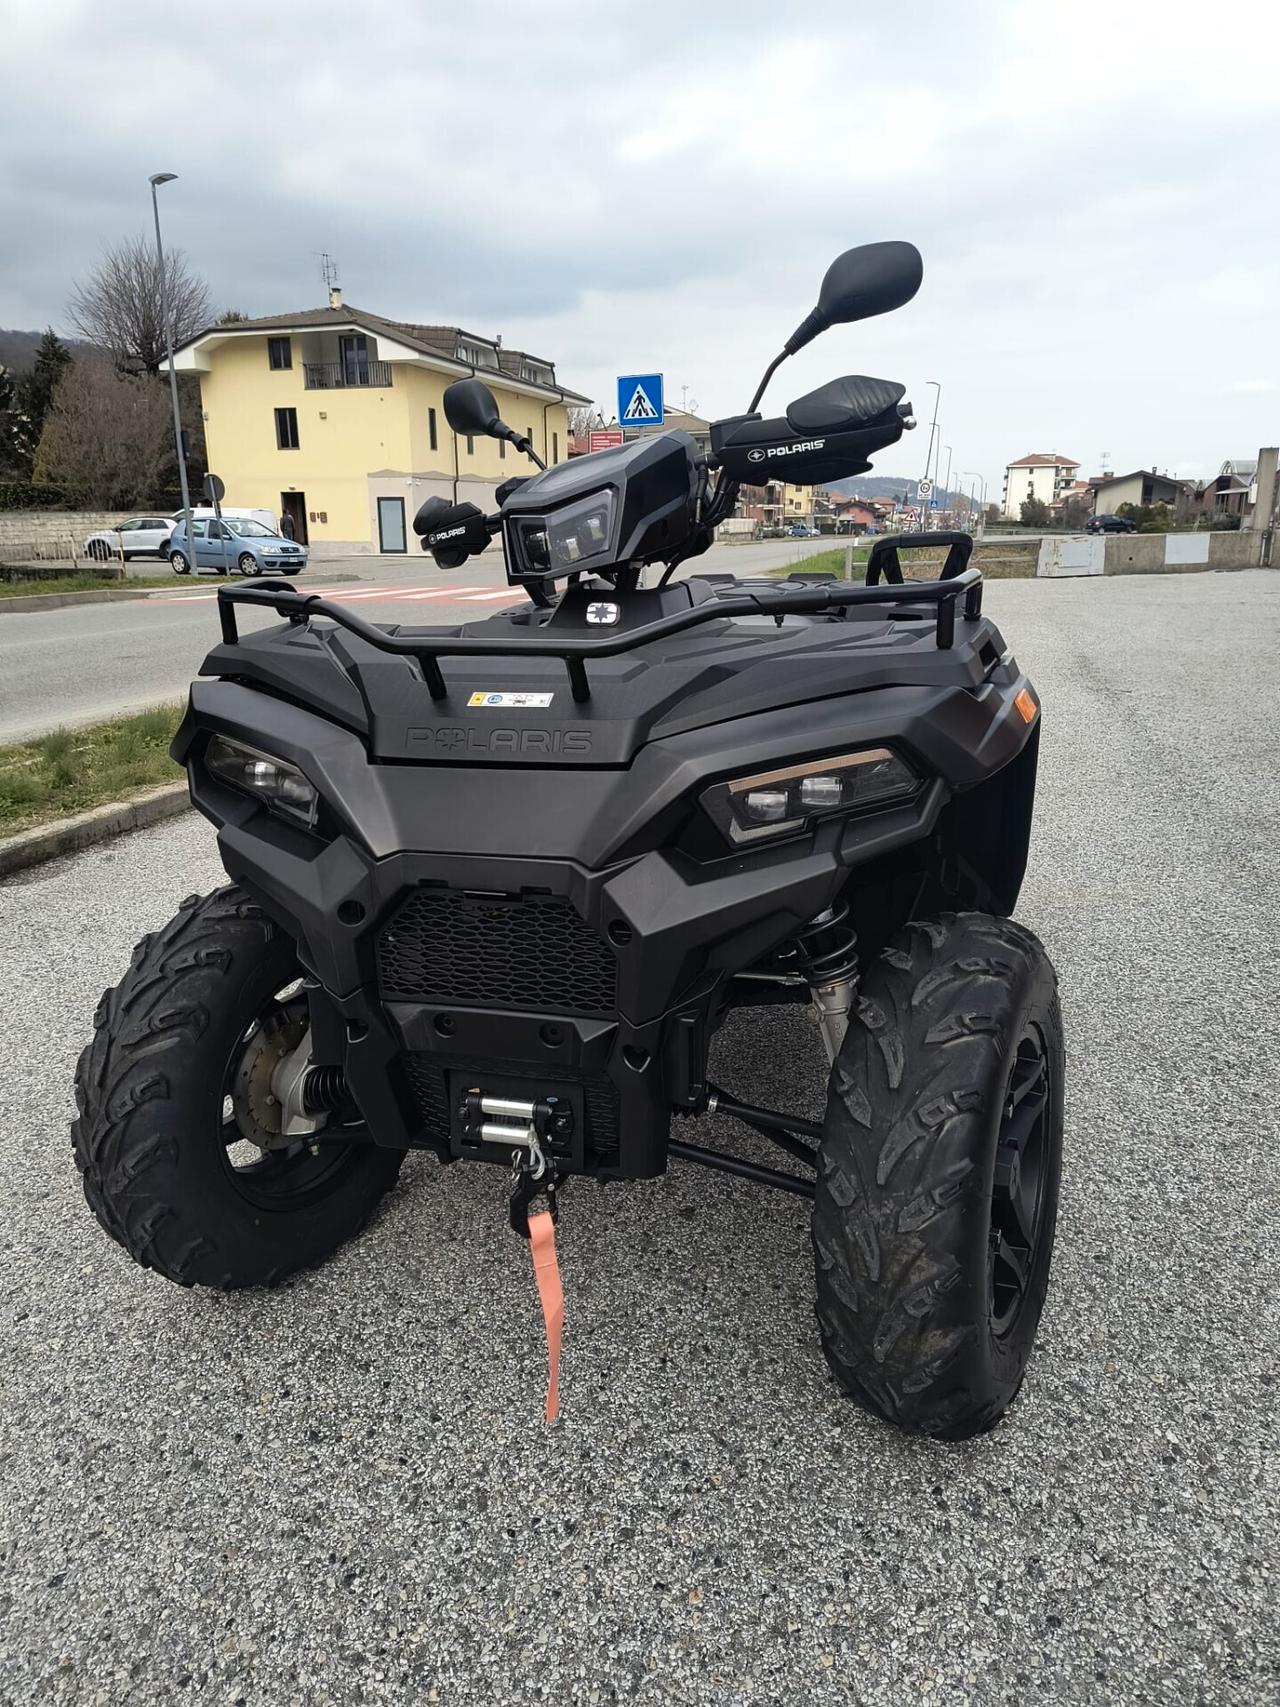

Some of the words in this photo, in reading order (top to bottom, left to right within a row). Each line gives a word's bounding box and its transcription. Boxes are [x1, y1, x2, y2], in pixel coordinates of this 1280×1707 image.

[767, 439, 826, 458] POLARIS
[436, 526, 466, 540] POLARIS
[406, 727, 593, 754] POLARIS
